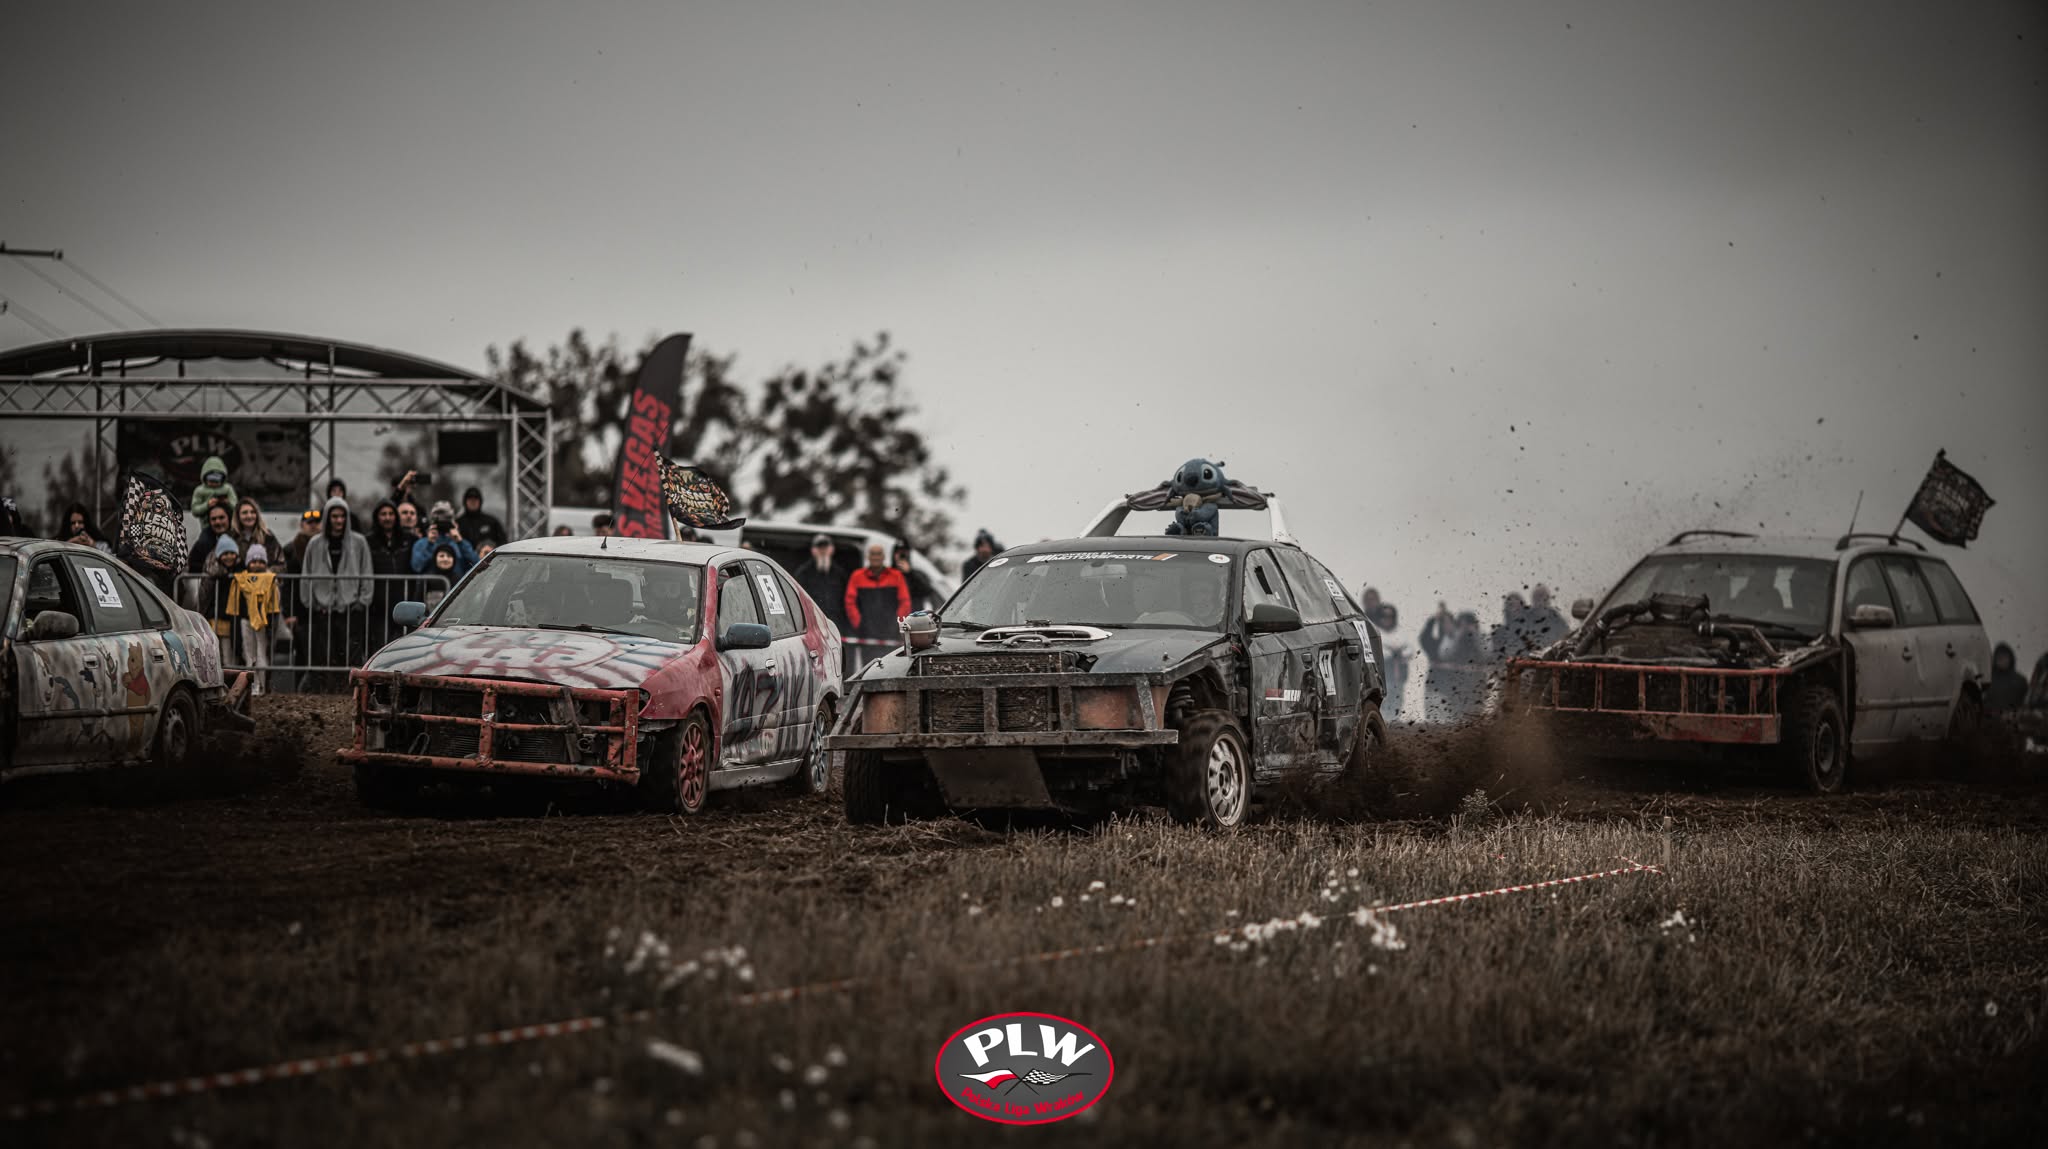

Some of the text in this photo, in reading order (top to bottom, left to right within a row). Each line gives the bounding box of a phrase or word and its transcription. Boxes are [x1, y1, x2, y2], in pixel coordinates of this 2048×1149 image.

[169, 433, 234, 456] PLW
[621, 388, 659, 511] VEGAS
[93, 570, 110, 596] 8
[762, 577, 776, 602] 5
